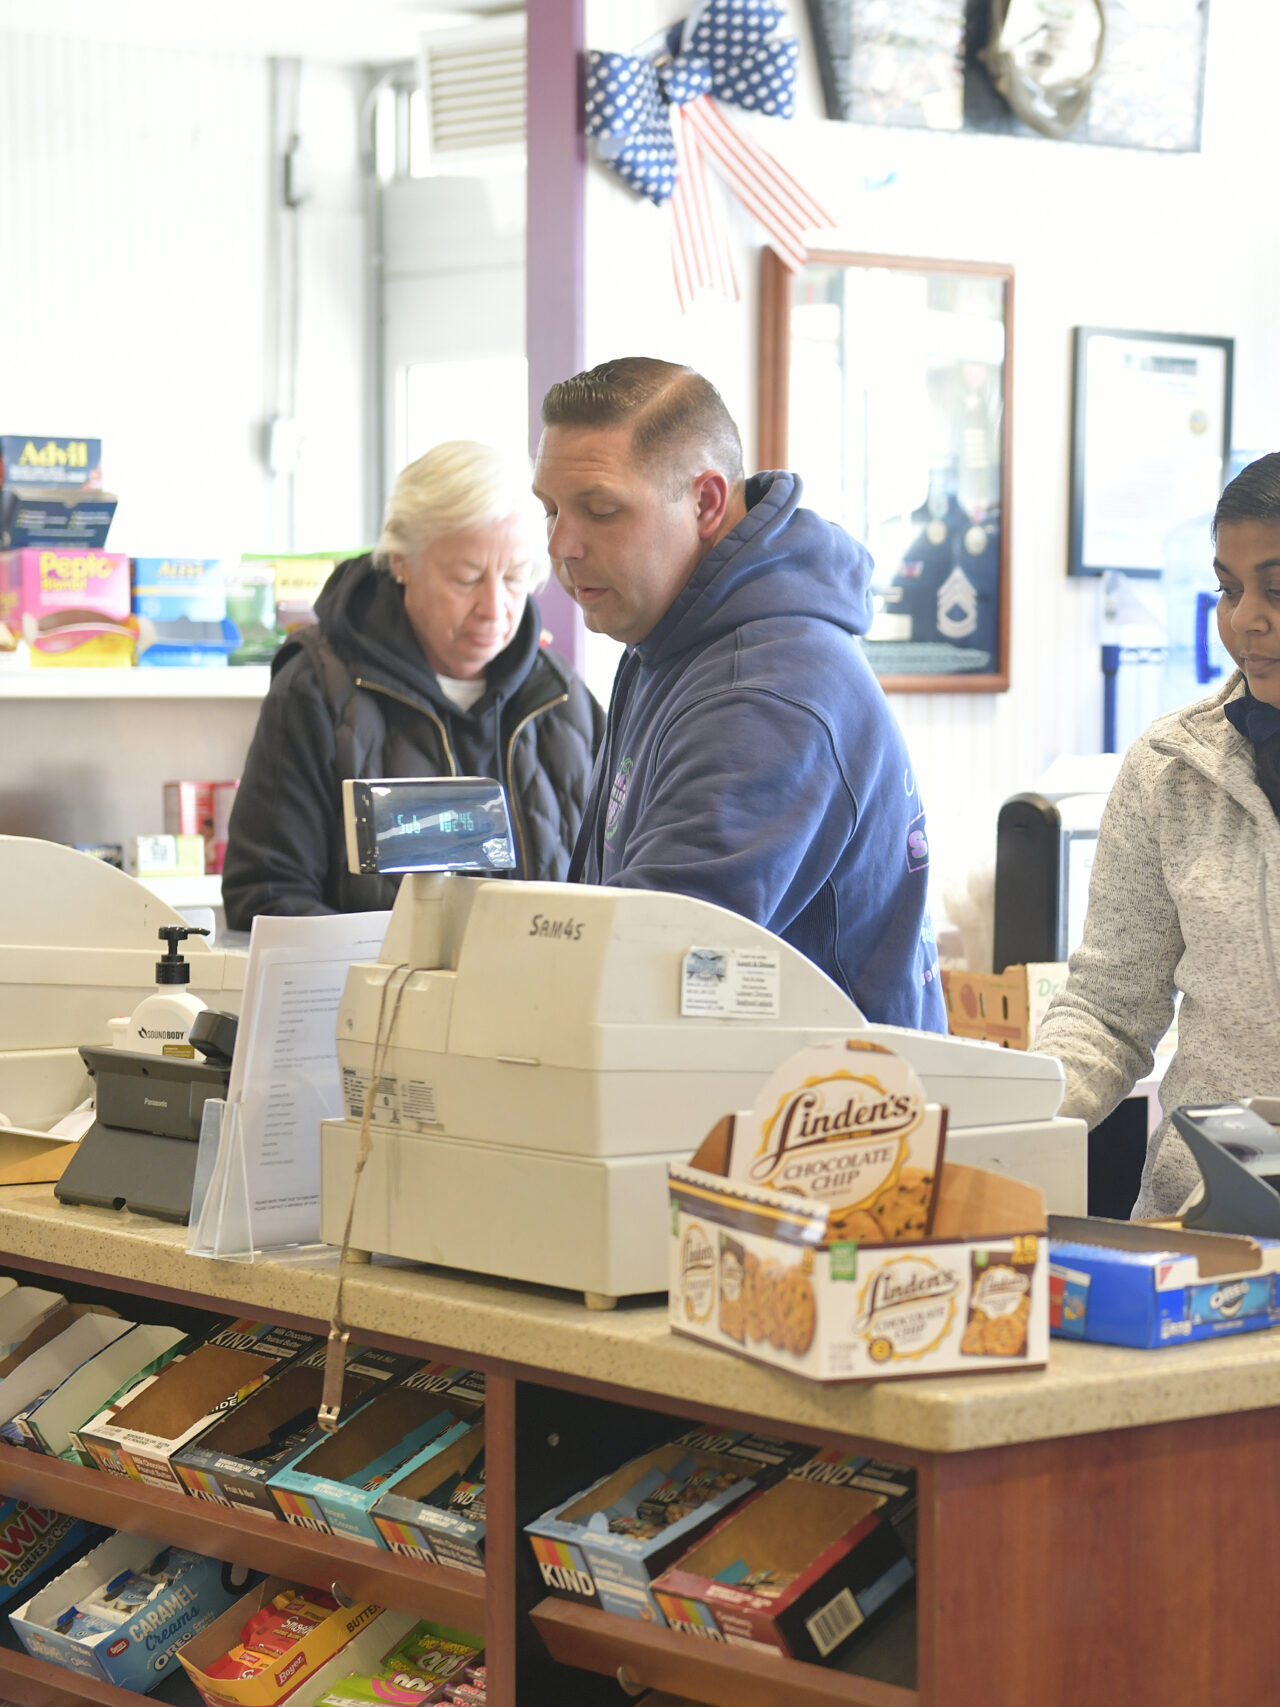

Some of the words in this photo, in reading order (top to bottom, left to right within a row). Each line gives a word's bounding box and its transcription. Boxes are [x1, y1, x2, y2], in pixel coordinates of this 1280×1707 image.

[18, 440, 88, 467] Advil
[40, 551, 112, 579] Pepto
[146, 1030, 185, 1040] SOUNDBODY
[753, 1092, 917, 1179] Linden's
[784, 1147, 893, 1180] CHOCOLATE
[811, 1169, 861, 1192] CHIP
[209, 1329, 258, 1350] KIND
[400, 1371, 454, 1393] KIND
[675, 1432, 734, 1452] KIND
[792, 1459, 854, 1486] KIND
[8, 1543, 49, 1584] COOKIES
[538, 1562, 596, 1597] KIND
[129, 1584, 199, 1643] CARAMEL
[145, 1606, 200, 1651] Creams
[154, 1632, 193, 1672] OREO
[279, 1656, 305, 1685] Boyer
